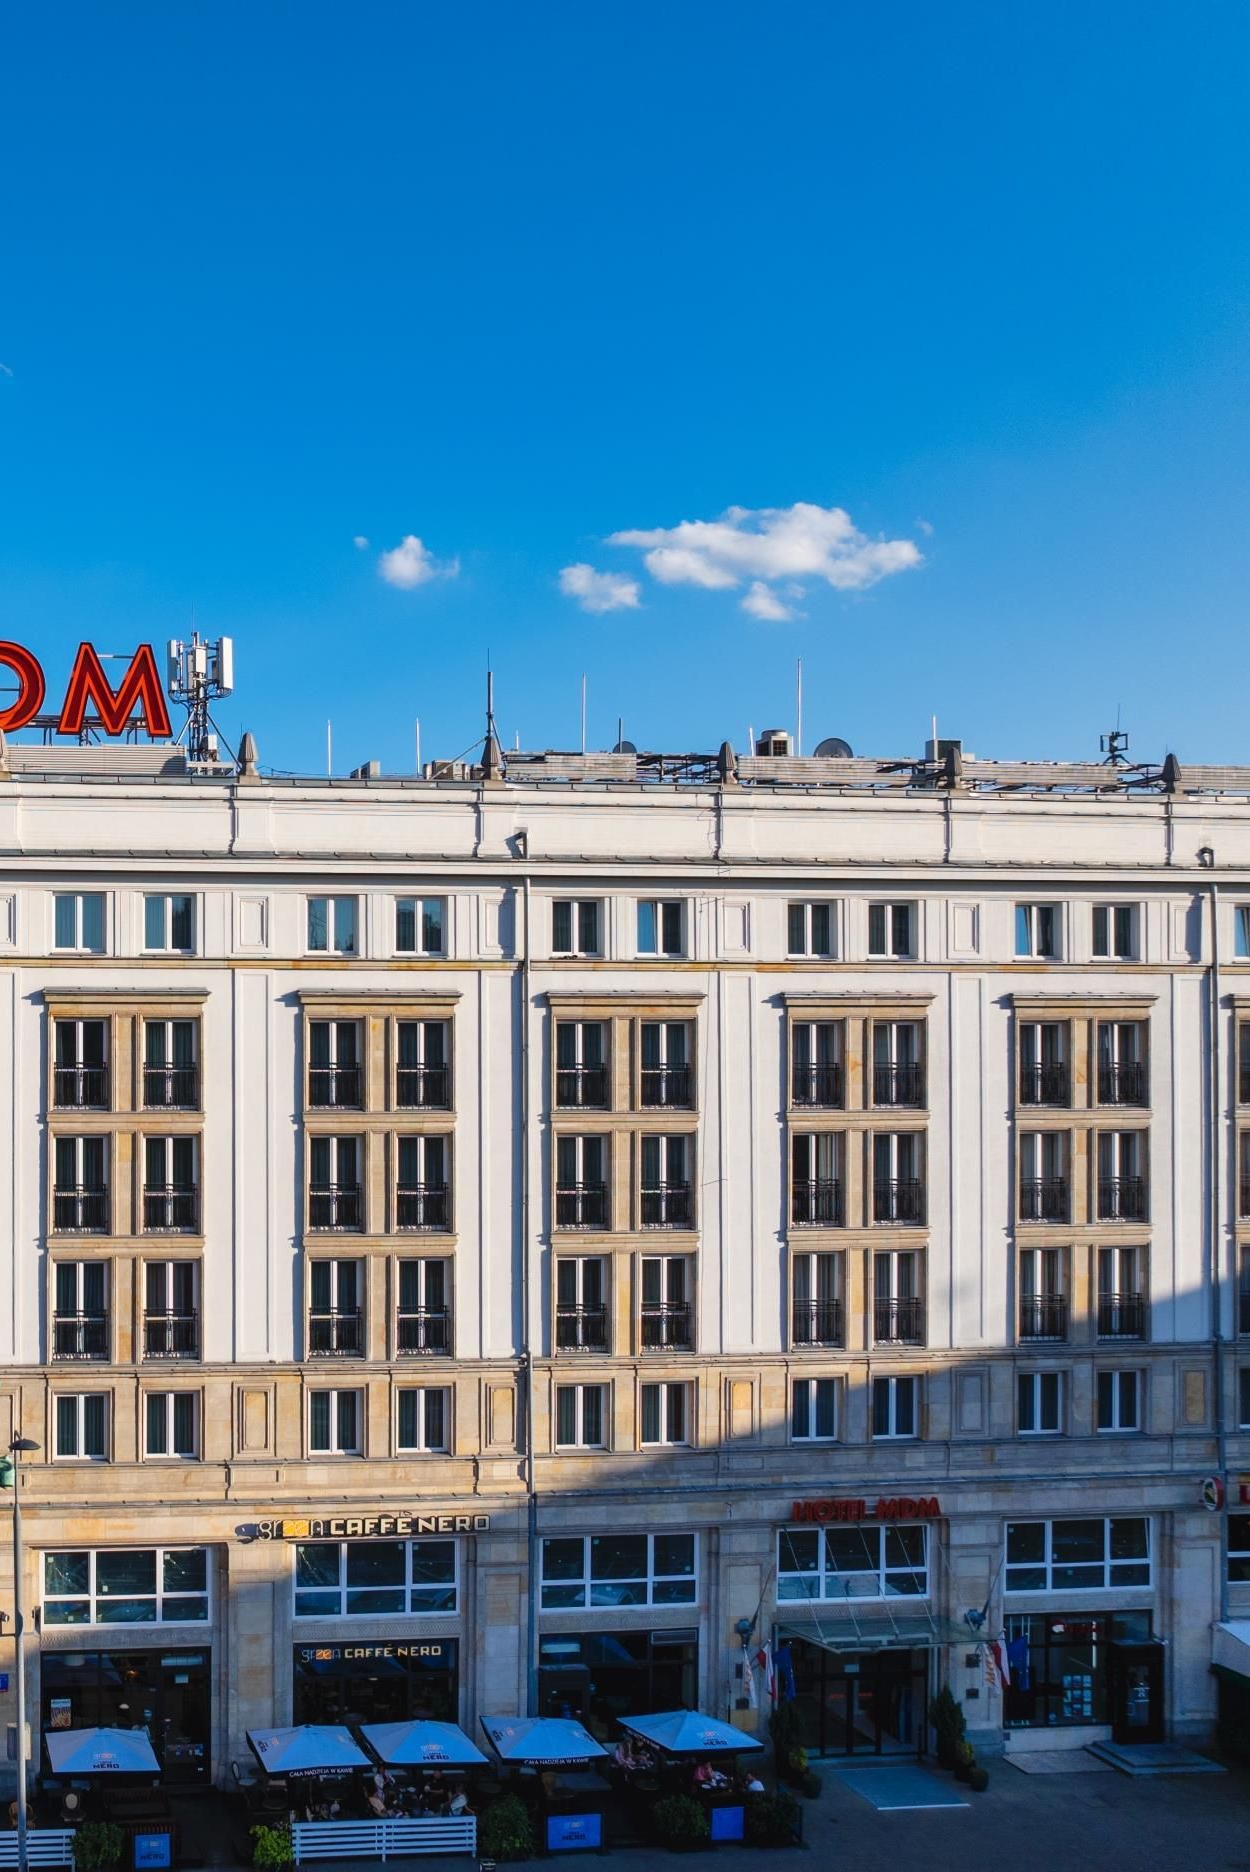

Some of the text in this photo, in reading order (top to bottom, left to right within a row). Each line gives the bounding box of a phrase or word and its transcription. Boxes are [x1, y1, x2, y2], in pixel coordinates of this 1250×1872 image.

[877, 1495, 941, 1519] MDM
[417, 1514, 491, 1533] NERO
[397, 1645, 442, 1657] NERO
